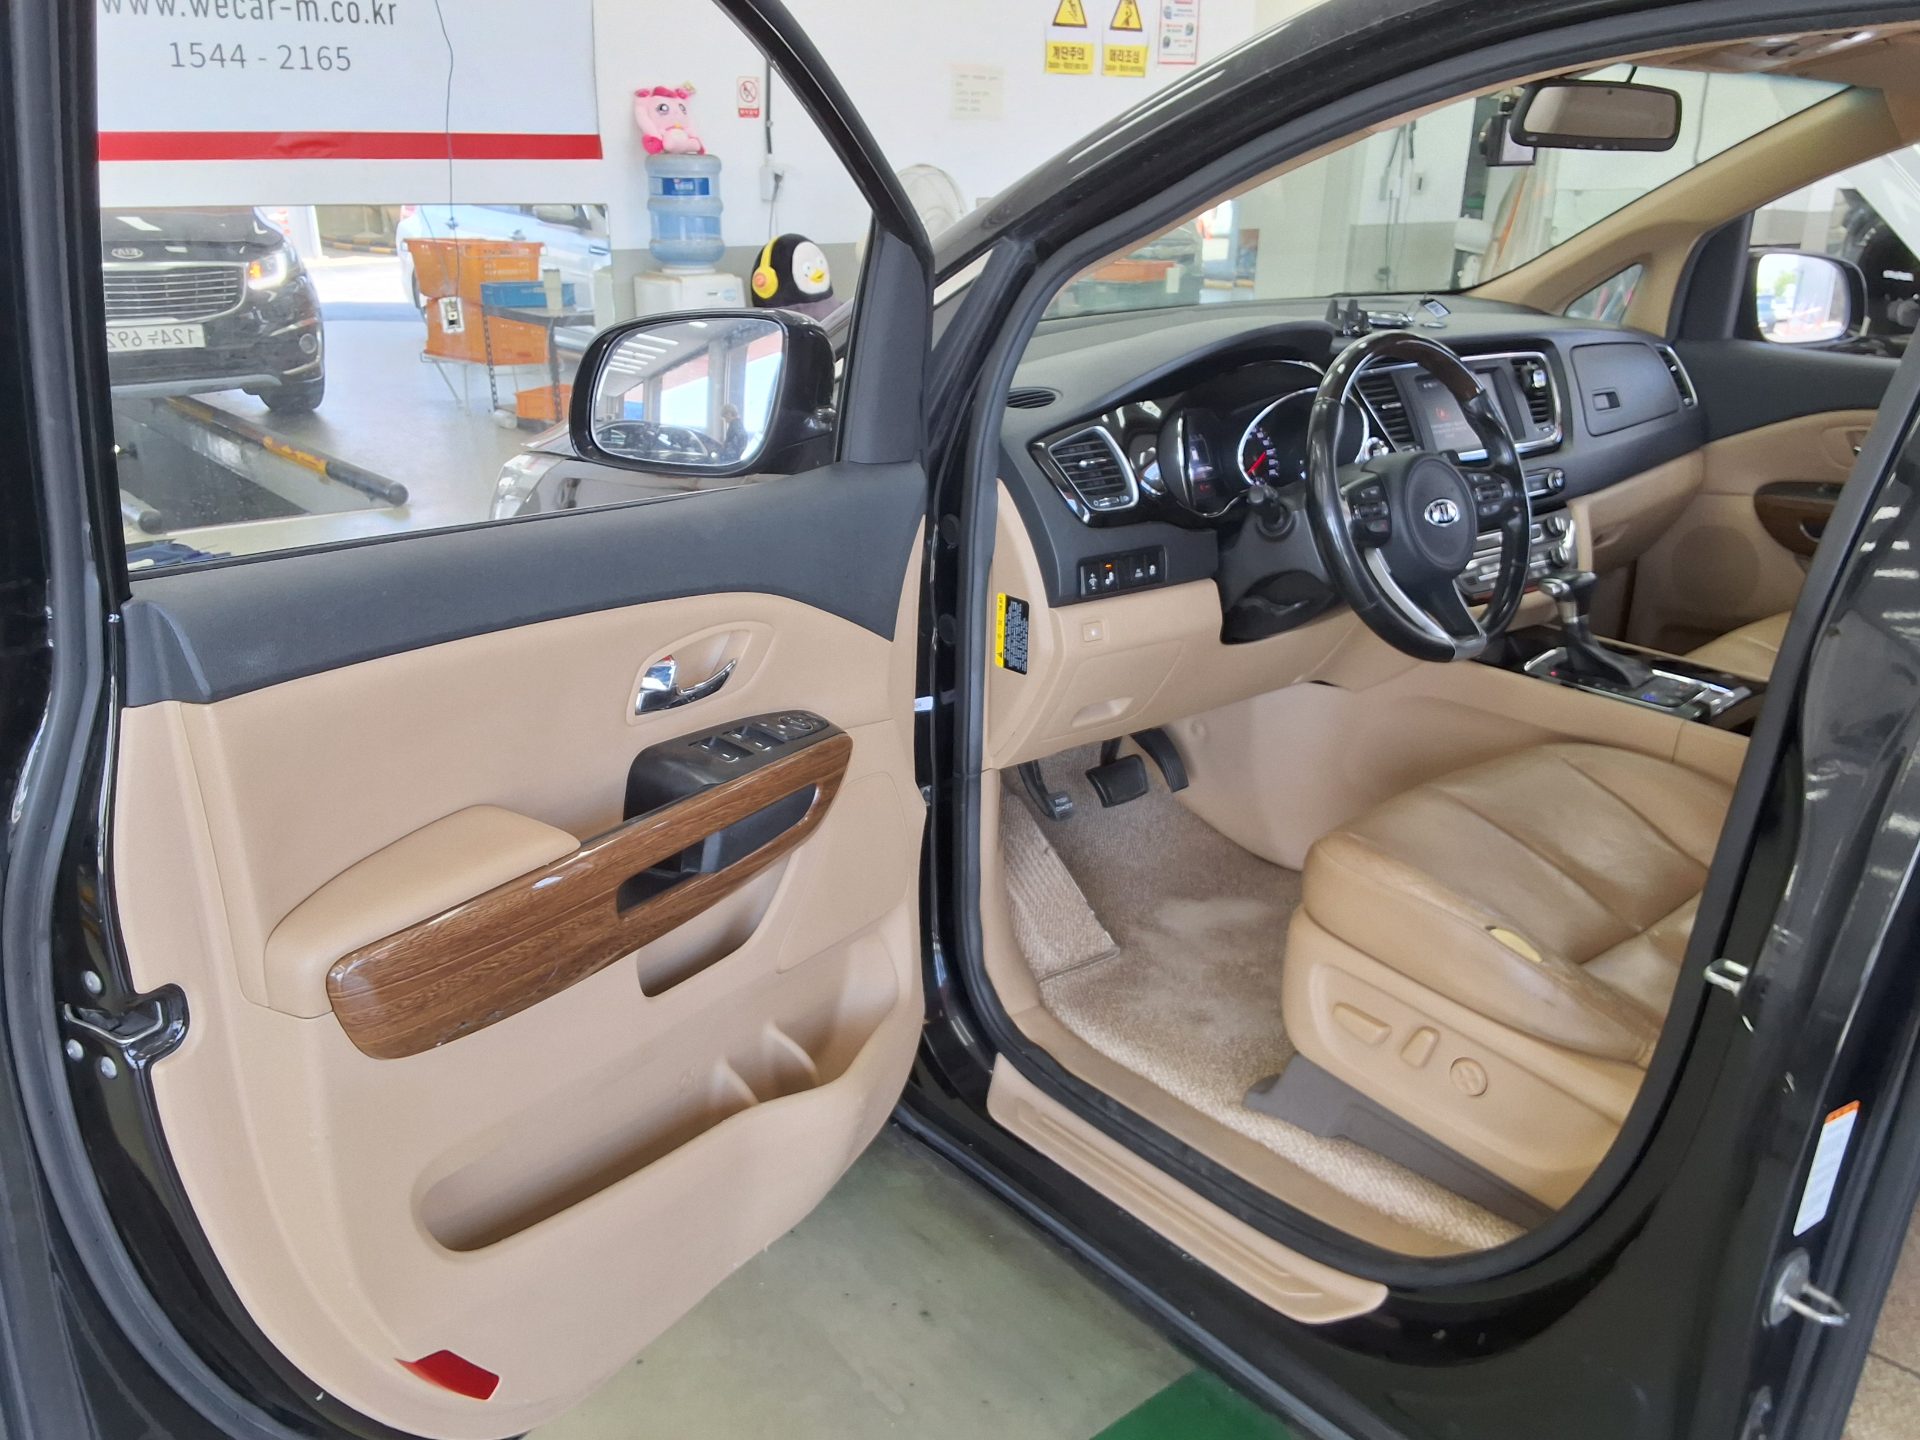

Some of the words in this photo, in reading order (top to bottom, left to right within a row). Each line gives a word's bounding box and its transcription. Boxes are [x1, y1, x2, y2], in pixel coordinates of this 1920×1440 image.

[101, 0, 397, 25] www.wecar-m.co.kr
[169, 41, 247, 70] 1544
[278, 44, 352, 72] 2165
